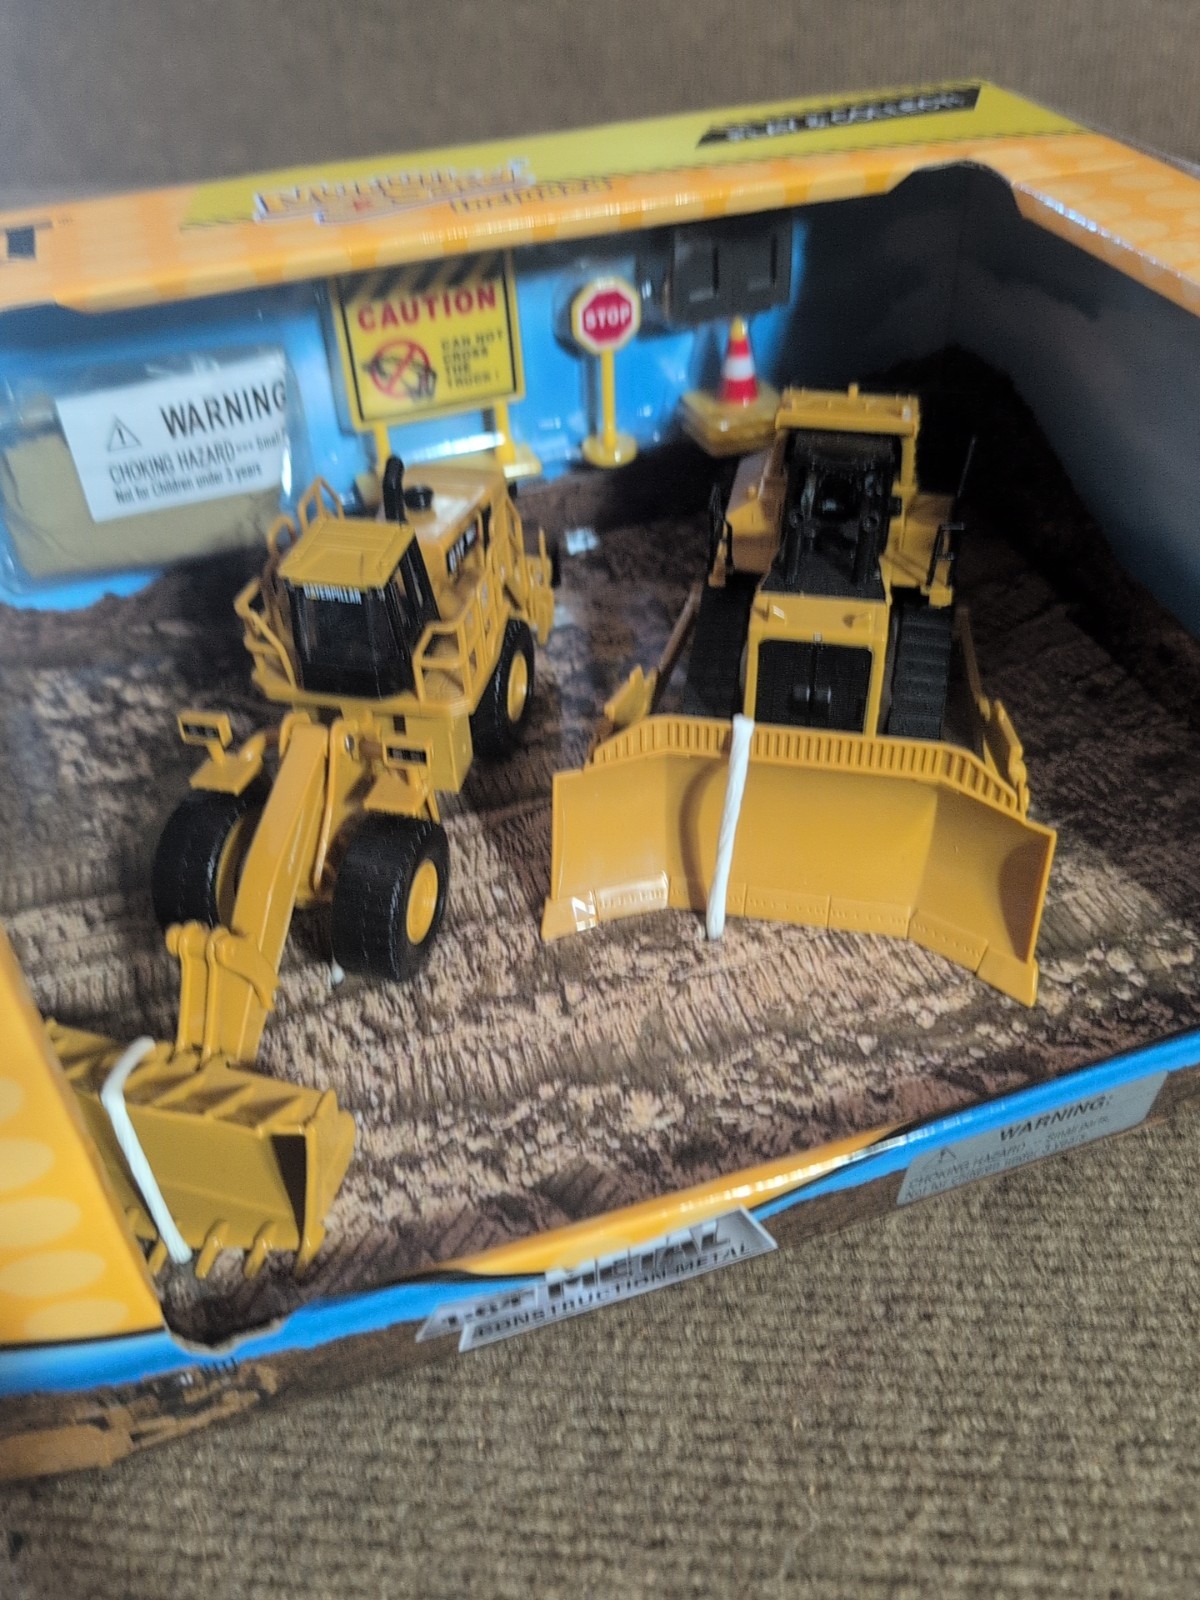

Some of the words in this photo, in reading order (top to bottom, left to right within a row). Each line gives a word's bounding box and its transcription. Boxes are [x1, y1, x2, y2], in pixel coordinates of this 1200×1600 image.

[357, 282, 497, 334] CAUTION
[584, 304, 631, 330] STOP
[159, 380, 287, 440] WARNING
[109, 452, 175, 486] CHOKING
[176, 440, 235, 473] HAZARD
[1000, 1094, 1114, 1141] WARNING:
